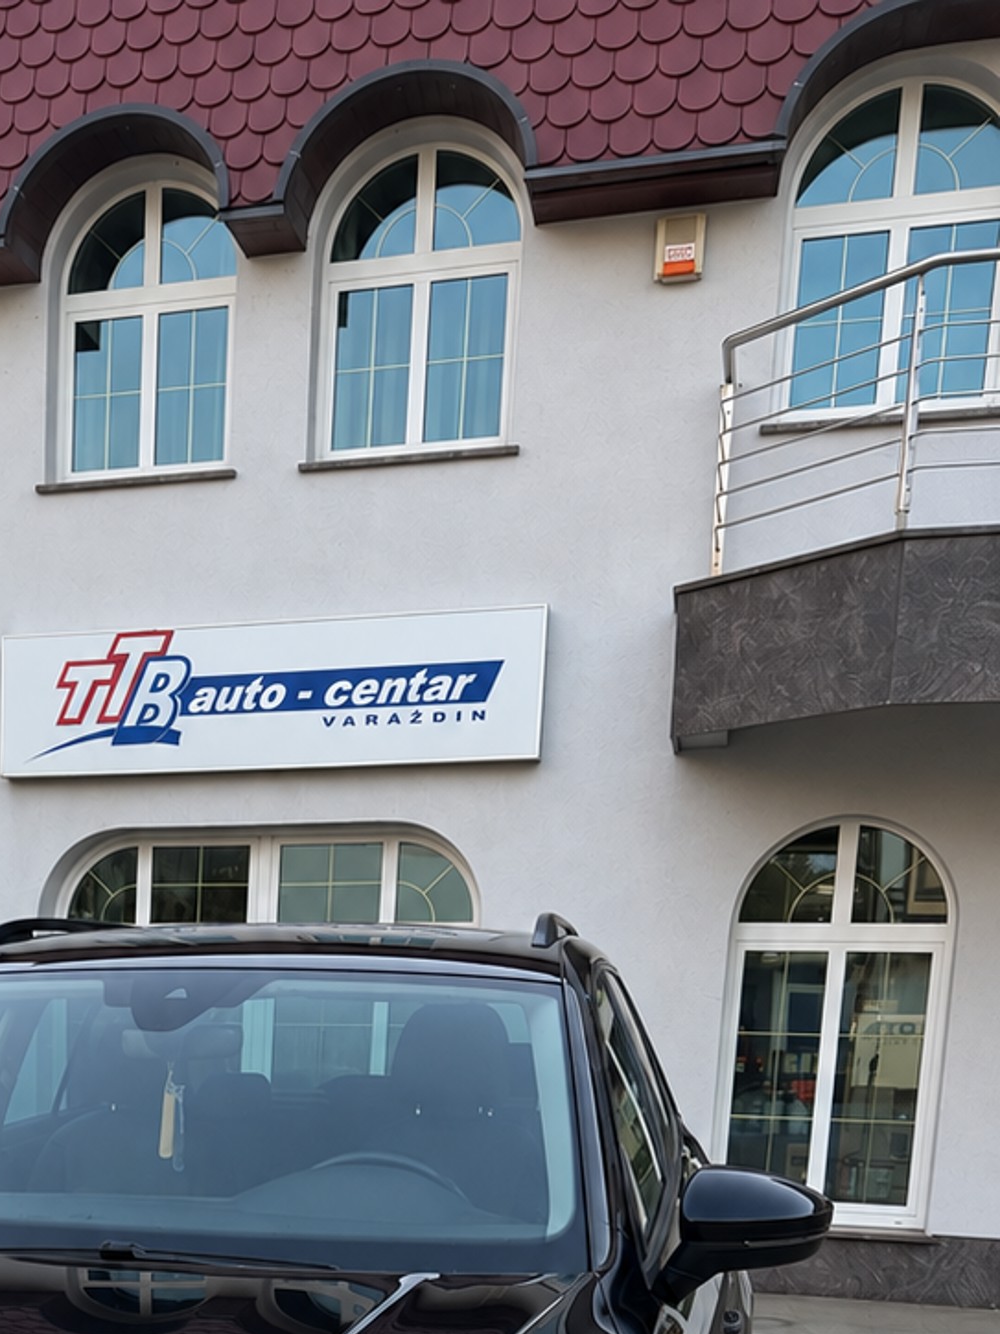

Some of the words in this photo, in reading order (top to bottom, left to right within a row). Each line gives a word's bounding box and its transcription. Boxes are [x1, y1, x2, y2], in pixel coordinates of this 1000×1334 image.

[187, 676, 287, 714] auto
[324, 668, 477, 707] centar
[322, 709, 487, 728] VARAŽDIN
